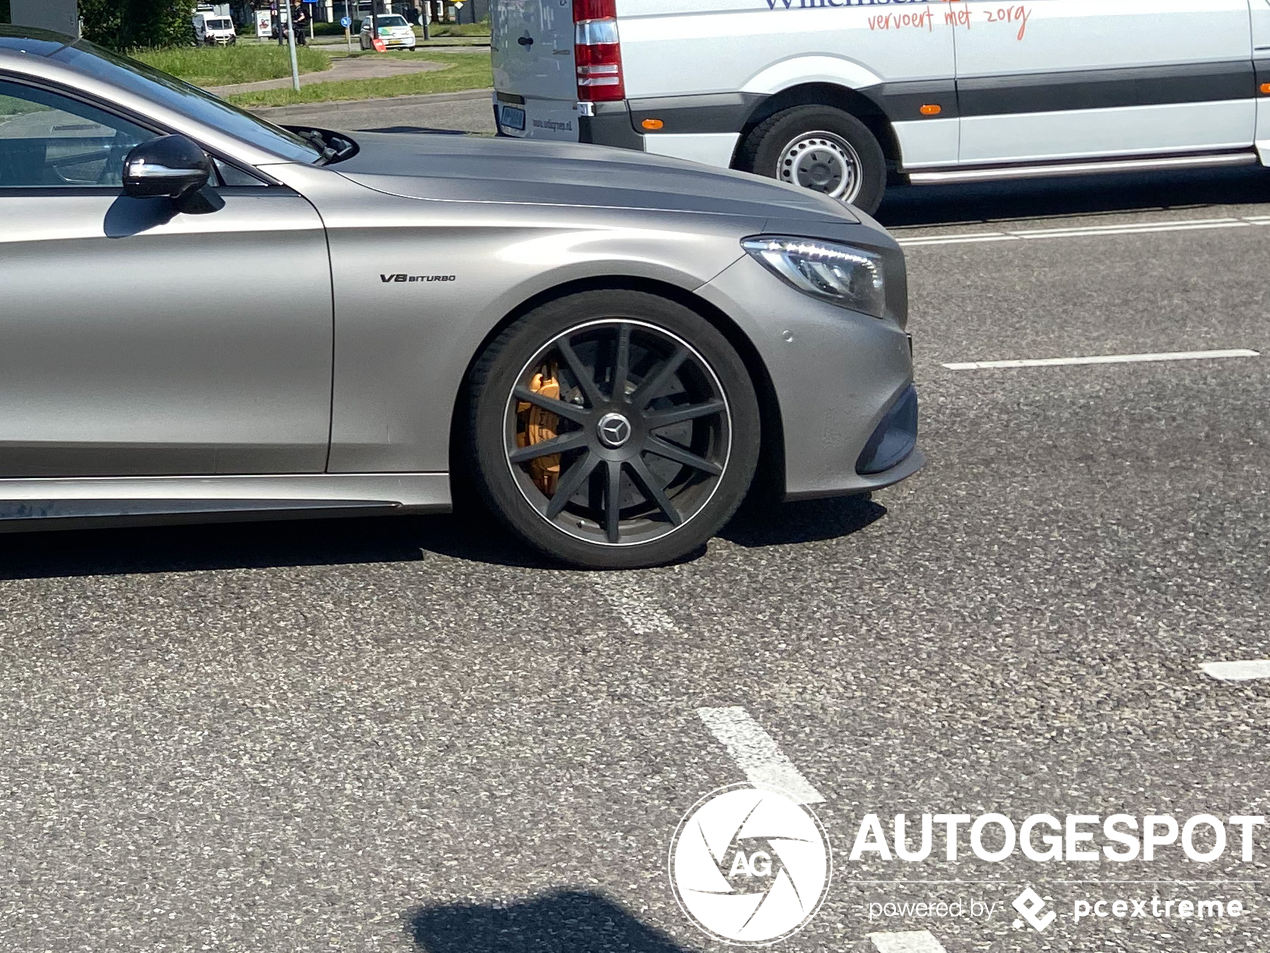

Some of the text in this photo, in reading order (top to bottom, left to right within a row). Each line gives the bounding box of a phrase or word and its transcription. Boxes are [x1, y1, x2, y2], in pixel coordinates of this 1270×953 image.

[868, 3, 1032, 40] vervoert met zorg
[380, 274, 408, 283] V8
